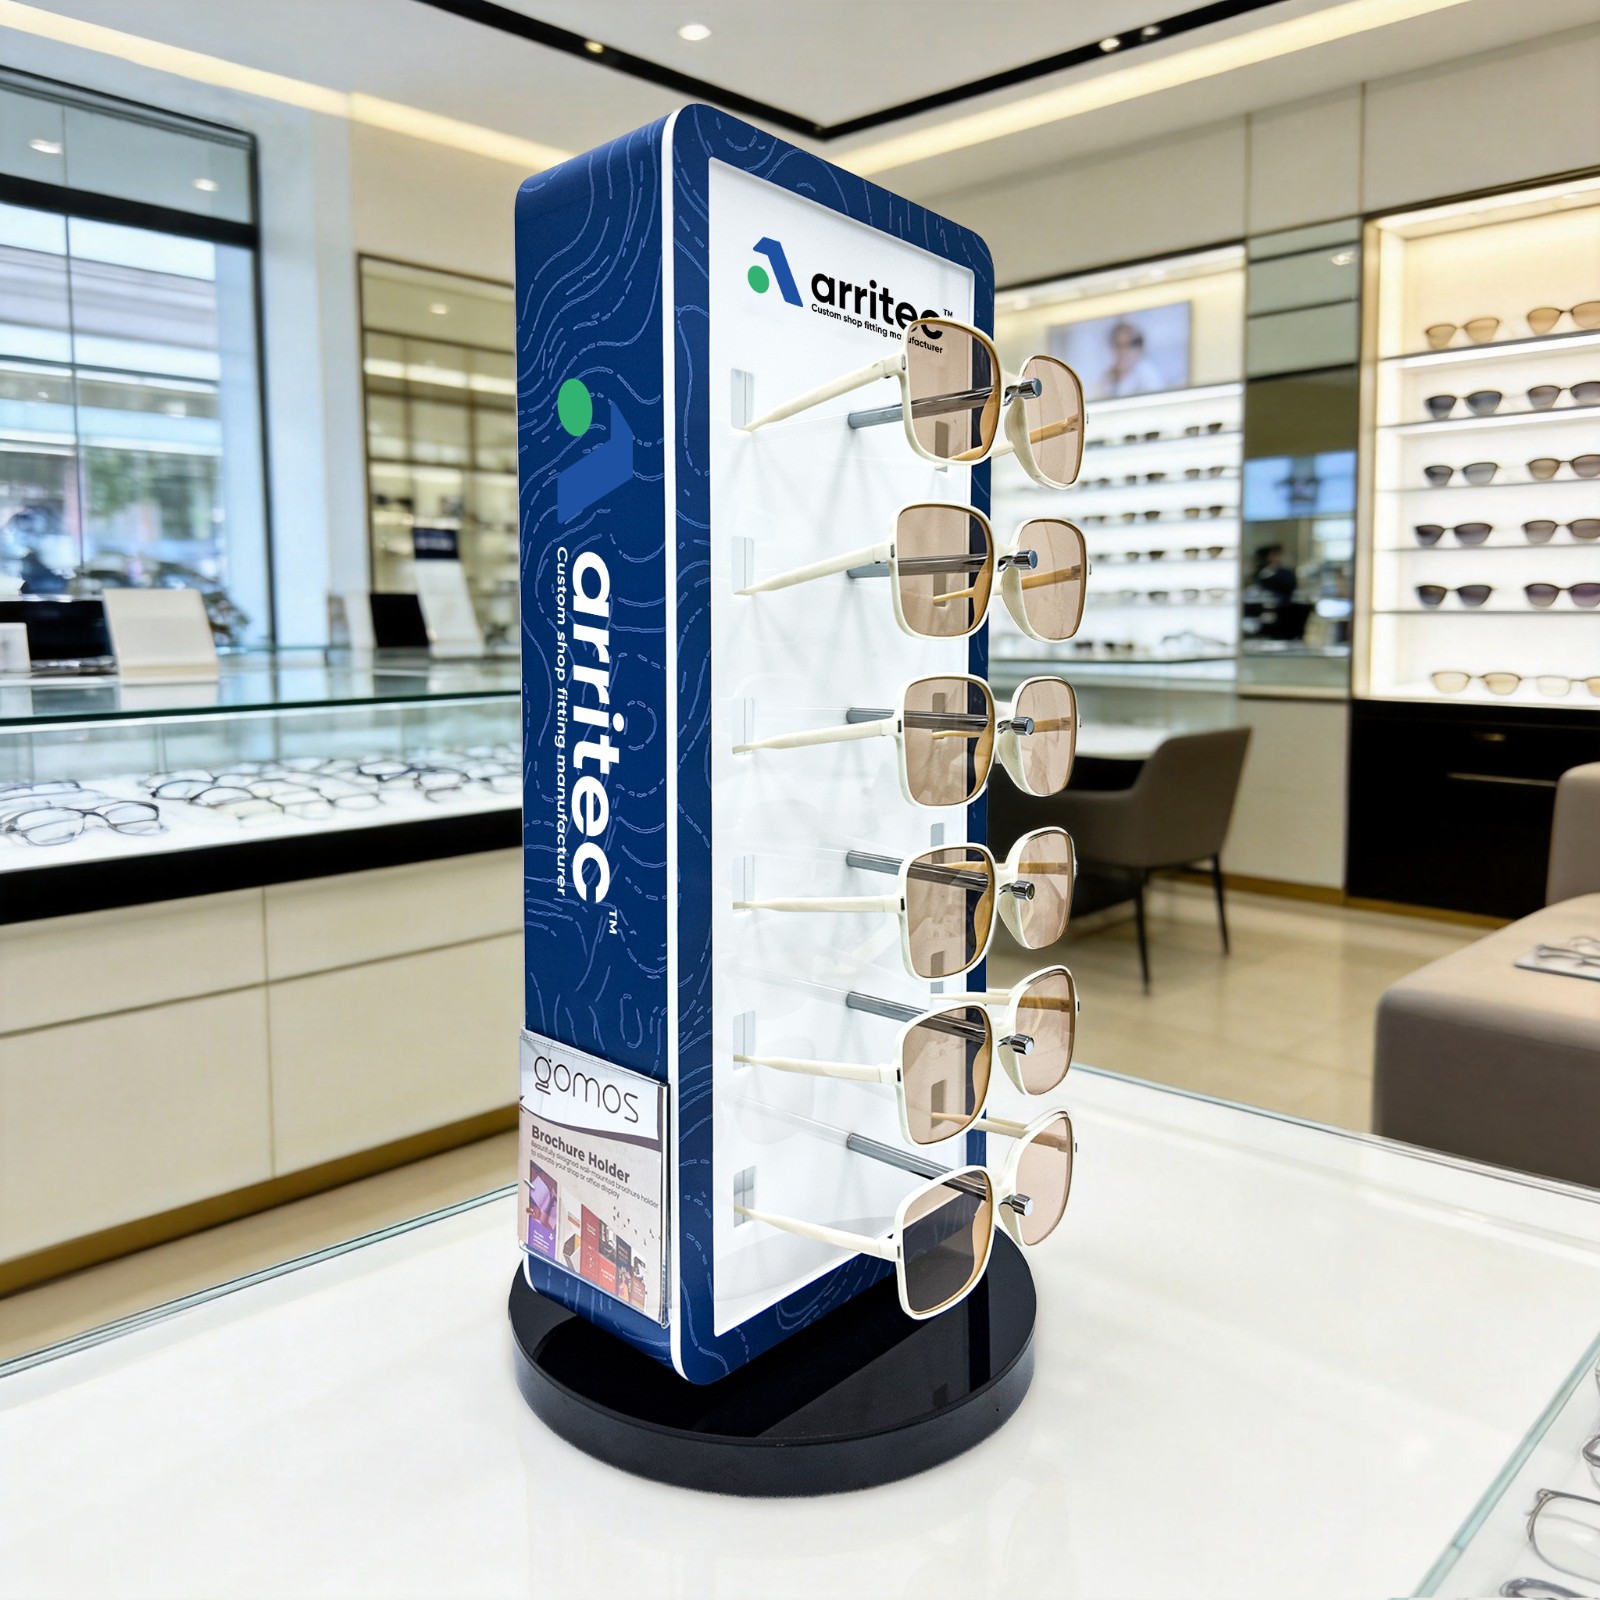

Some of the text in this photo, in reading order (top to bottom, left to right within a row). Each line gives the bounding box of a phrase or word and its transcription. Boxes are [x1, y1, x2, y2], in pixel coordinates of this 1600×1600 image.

[811, 273, 943, 340] arritec
[811, 303, 943, 354] Custom shop fitting maufacturer
[554, 546, 569, 897] Custom shop fitting manufacturer
[571, 551, 625, 903] arritec
[534, 1055, 639, 1123] gomos
[531, 1148, 537, 1157] to
[566, 1167, 580, 1179] shop
[600, 1184, 620, 1200] display
[532, 1124, 630, 1184] Brochure Holder
[555, 1153, 579, 1169] designed
[615, 1182, 641, 1200] brochure
[640, 1194, 659, 1209] holder
